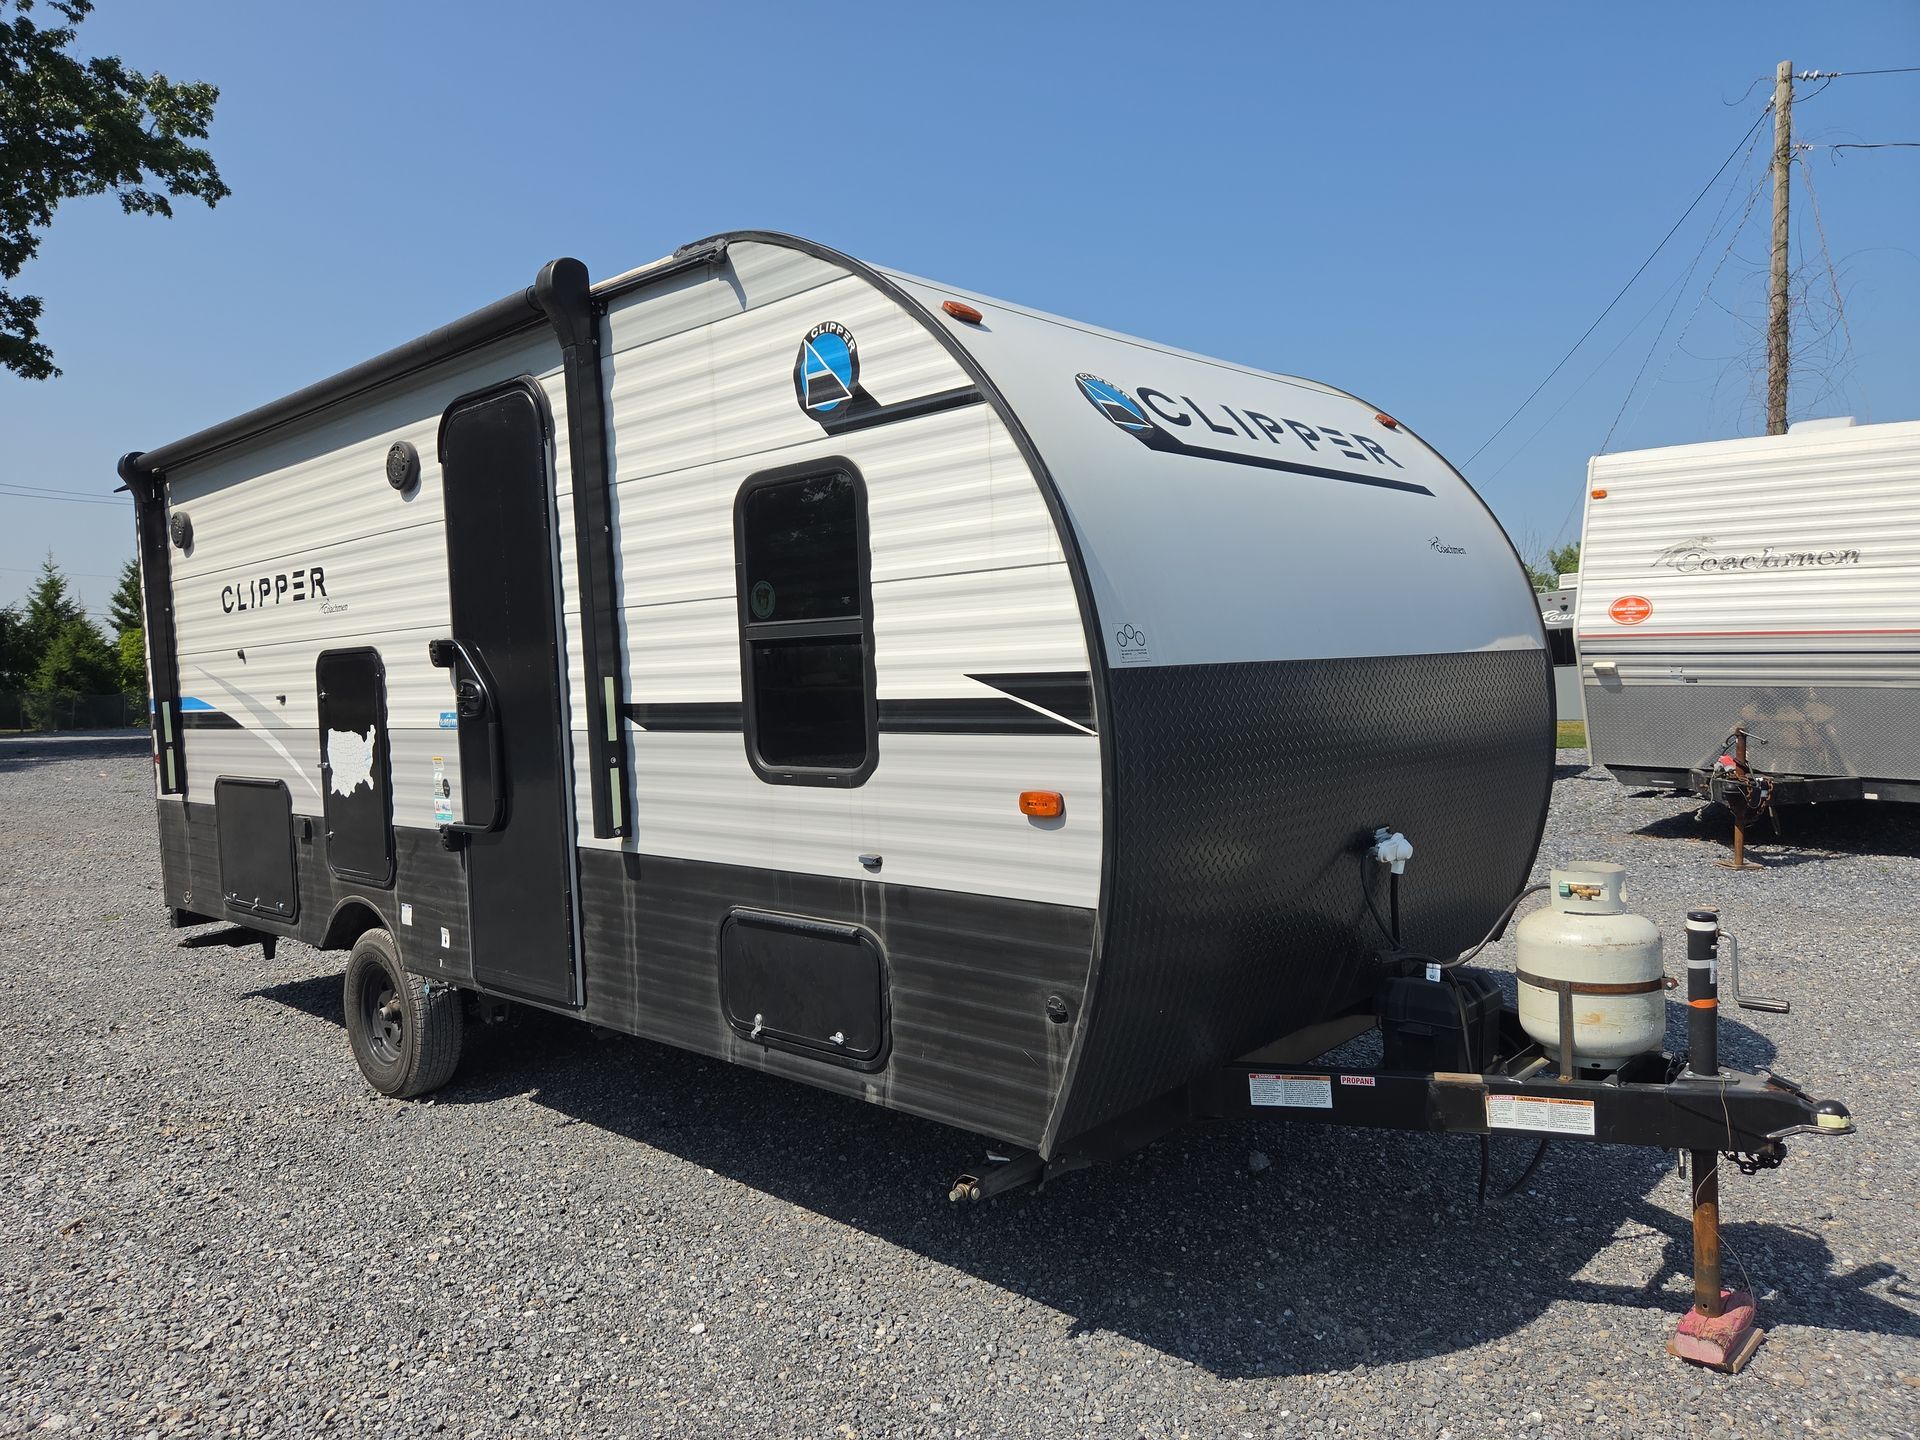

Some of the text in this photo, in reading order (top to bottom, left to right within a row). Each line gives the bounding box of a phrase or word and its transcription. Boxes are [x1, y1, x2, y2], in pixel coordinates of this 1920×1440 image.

[810, 322, 856, 354] CLIPPER
[1136, 386, 1406, 469] CLIPPER
[1436, 544, 1467, 555] Coachmen
[1675, 546, 1861, 573] Coachmen
[221, 566, 327, 614] CLIPPER
[1341, 1076, 1374, 1085] PROPANE
